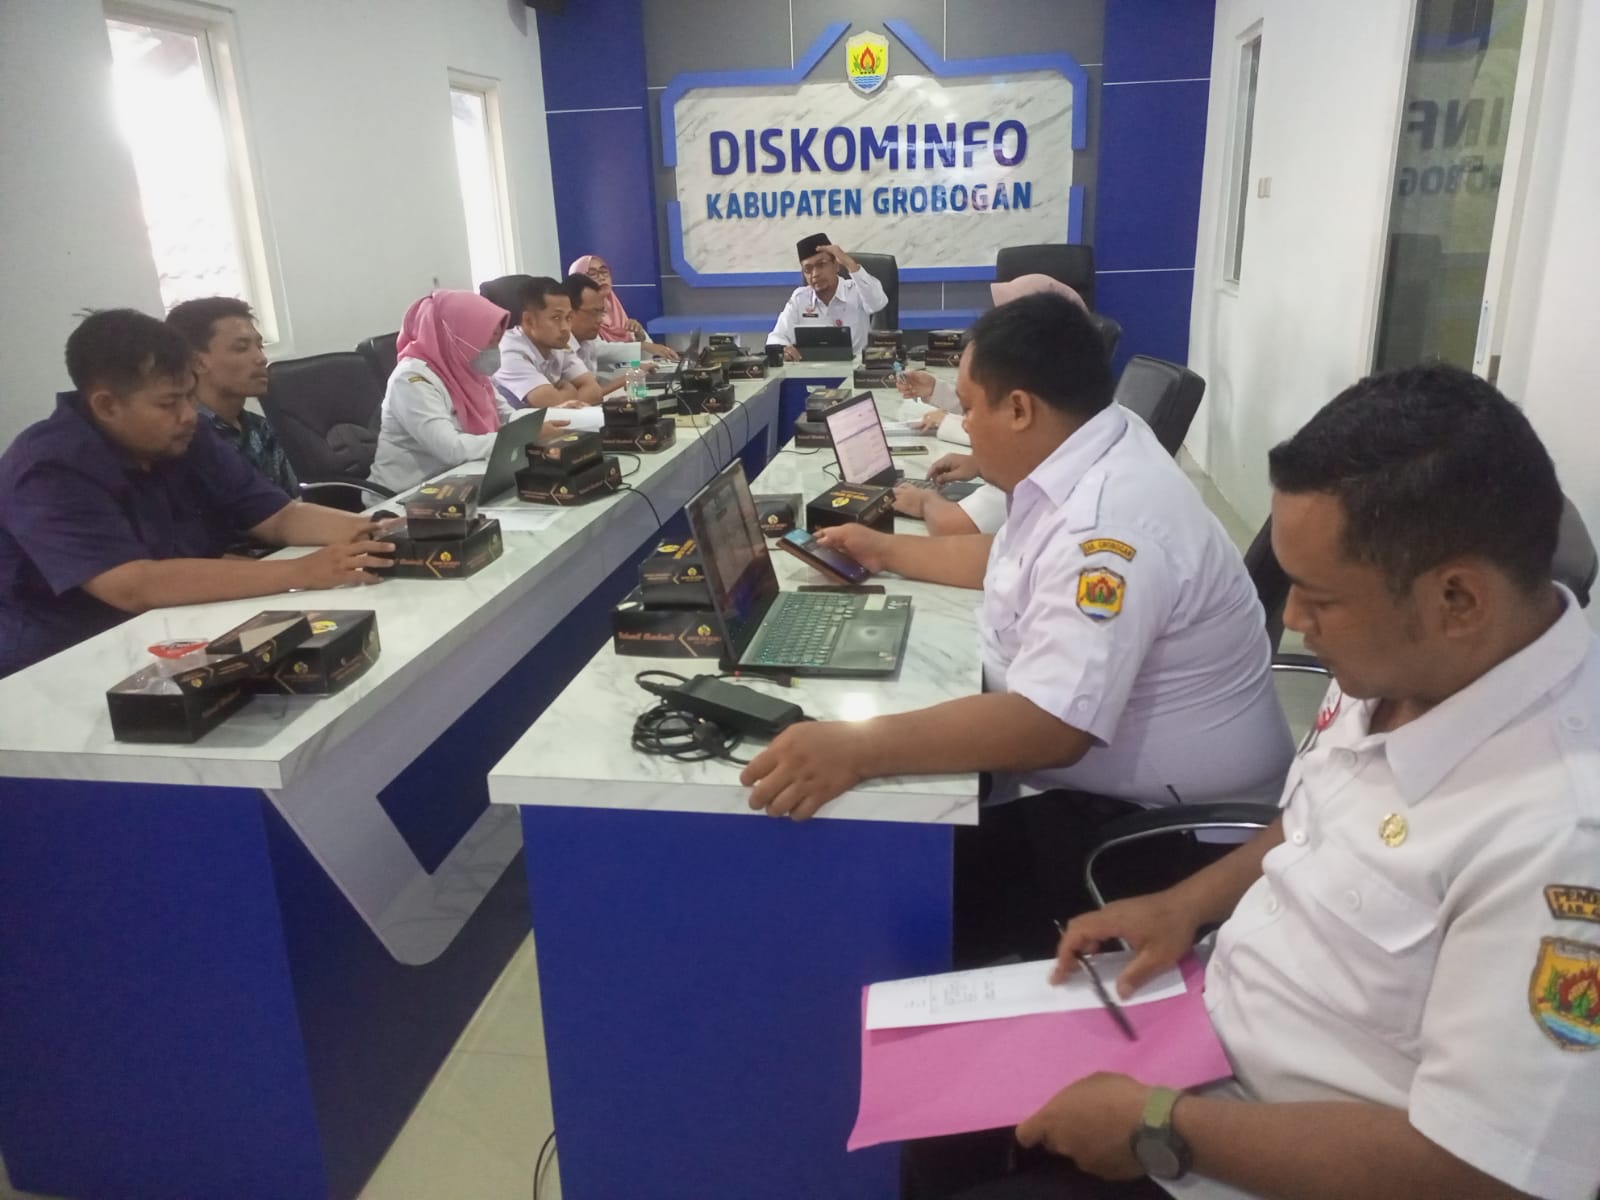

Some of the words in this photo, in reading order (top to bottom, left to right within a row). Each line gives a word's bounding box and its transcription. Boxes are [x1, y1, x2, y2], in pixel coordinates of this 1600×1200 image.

[709, 120, 1028, 176] DISKOMINFO
[706, 187, 863, 220] KABUPATEN
[872, 181, 1032, 215] GROBOGAN
